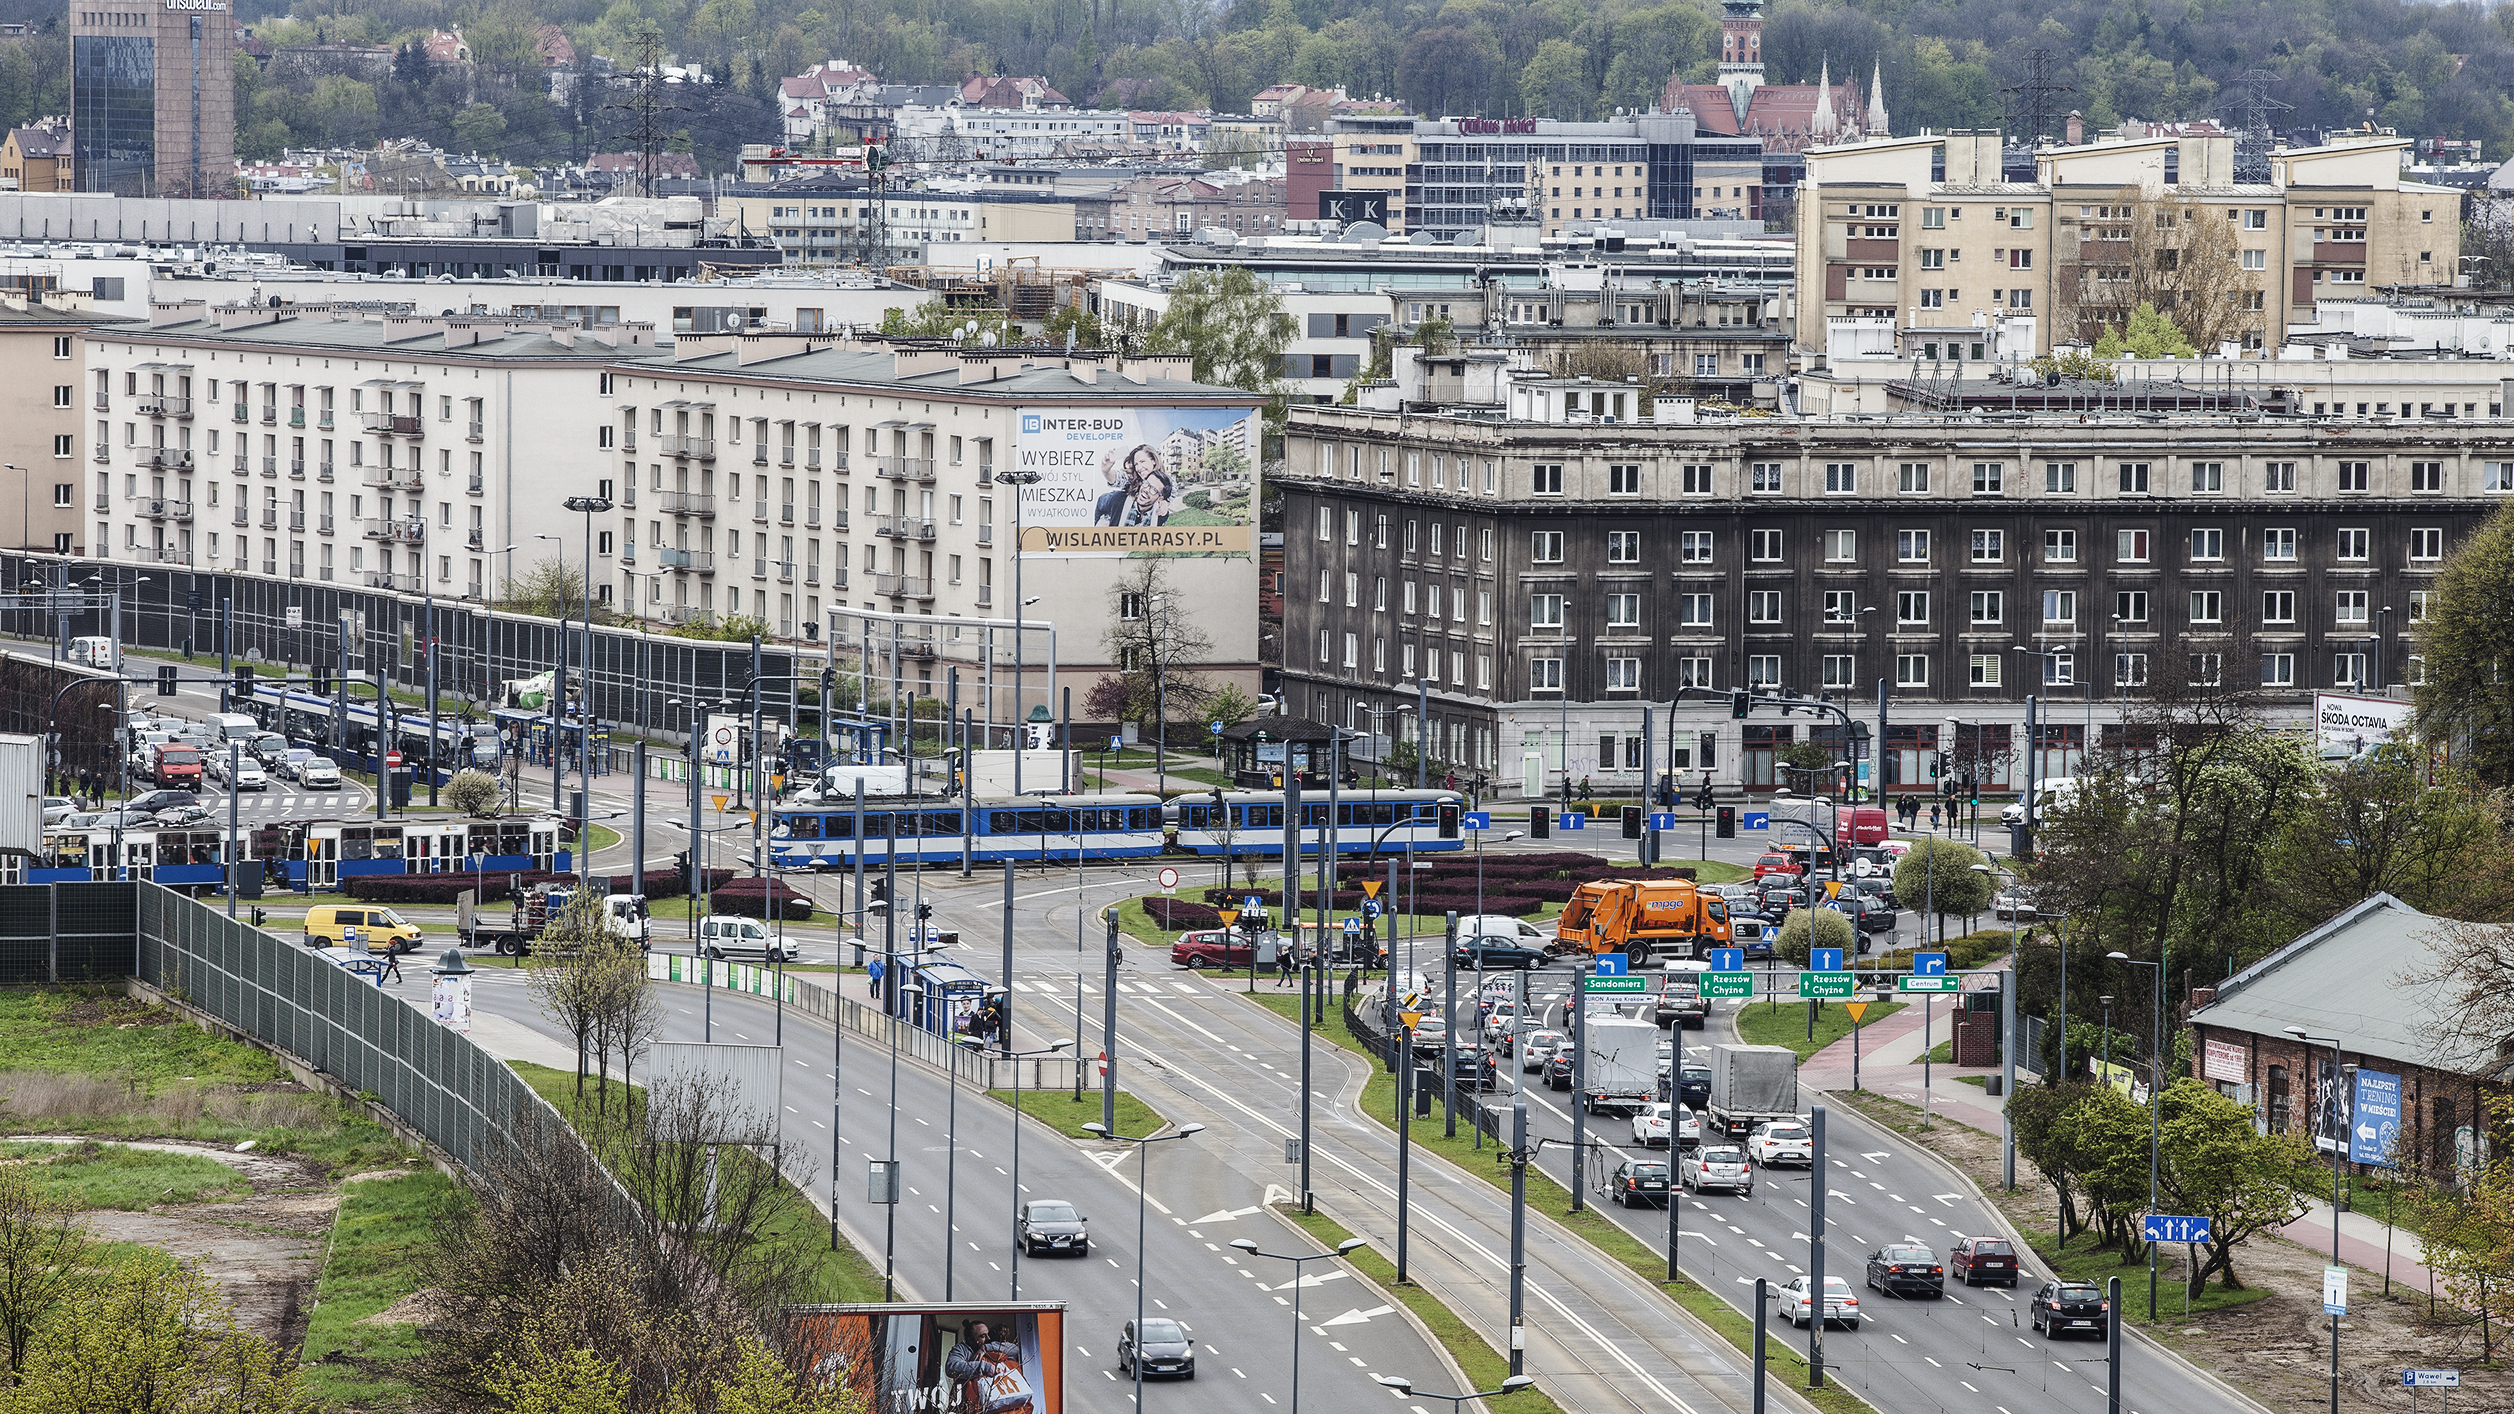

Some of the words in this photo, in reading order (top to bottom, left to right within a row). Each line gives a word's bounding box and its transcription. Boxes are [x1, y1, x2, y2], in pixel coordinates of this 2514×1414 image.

[1458, 115, 1500, 136] Qubus
[1503, 115, 1536, 133] Hotel
[1329, 200, 1345, 218] K
[1363, 200, 1379, 218] K
[1043, 419, 1123, 430] INTER-BUD
[1022, 451, 1094, 466] WYBIERZ
[1038, 469, 1058, 482] WÓJ
[1062, 472, 1084, 482] STYL
[1022, 488, 1094, 502] MIESZKAJ
[1027, 508, 1088, 518] WYJĄTKOWO
[1046, 532, 1223, 547] WISLANETARASY.PL
[2326, 703, 2343, 712] NOWA
[2321, 708, 2349, 726] ŠKODA
[2351, 715, 2388, 730] OCTAVIA
[1590, 979, 1641, 988] Sandomierz
[1713, 975, 1750, 983] Rzeszów
[1813, 975, 1850, 983] Rzeszów
[1712, 985, 1744, 994] Chyżne
[1813, 985, 1844, 995] Chyżne
[2361, 1089, 2397, 1105] TRENING
[2360, 1103, 2368, 1112] W
